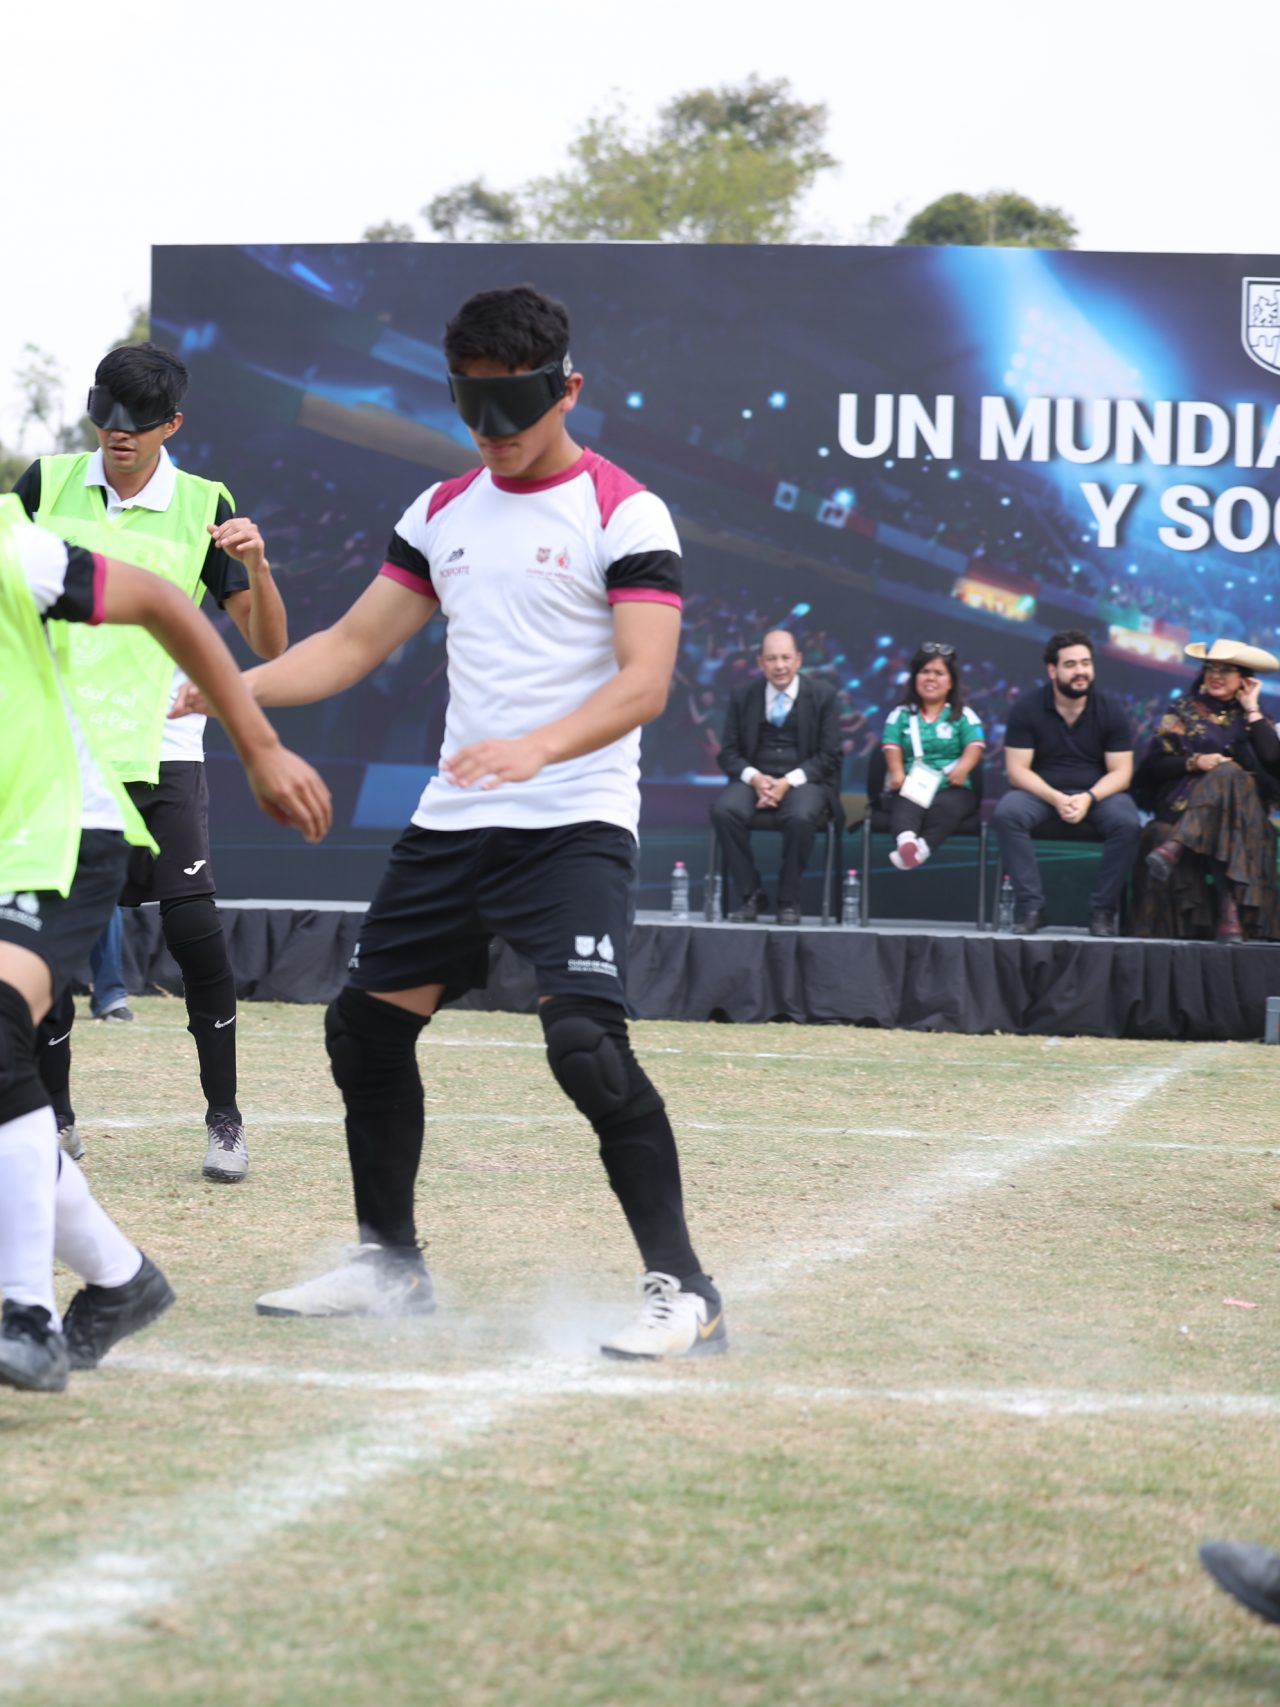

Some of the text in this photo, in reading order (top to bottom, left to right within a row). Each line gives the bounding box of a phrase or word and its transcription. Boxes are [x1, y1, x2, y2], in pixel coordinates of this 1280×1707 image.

[838, 393, 954, 459] UN
[1079, 482, 1280, 553] Y SO
